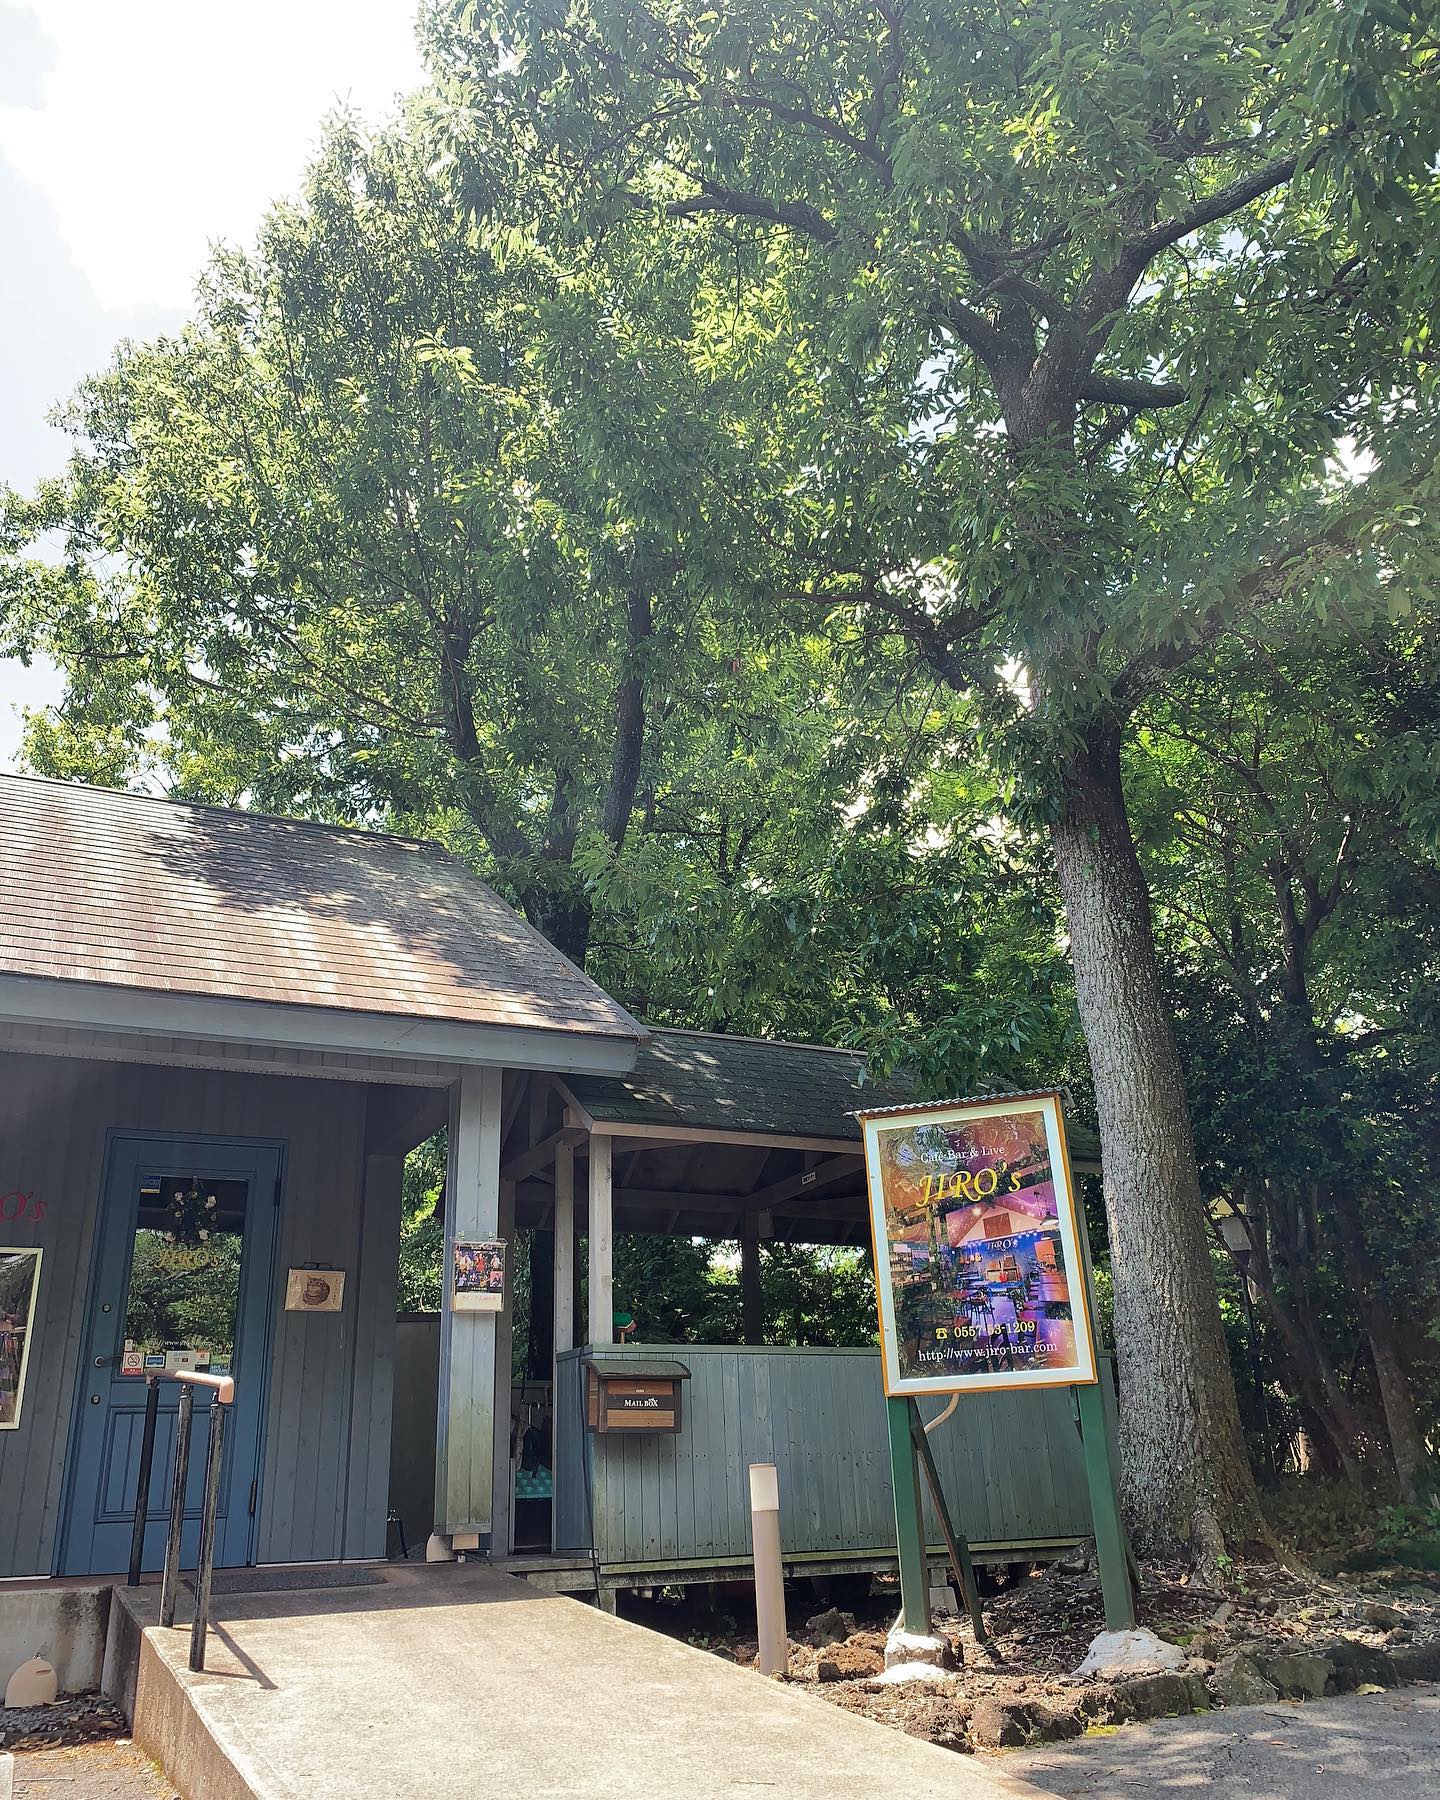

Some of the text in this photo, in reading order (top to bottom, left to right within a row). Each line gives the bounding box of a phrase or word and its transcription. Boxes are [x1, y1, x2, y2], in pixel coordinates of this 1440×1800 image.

[970, 1147, 979, 1158] &
[981, 1145, 1005, 1157] Live
[915, 1162, 1022, 1208] JIRO's
